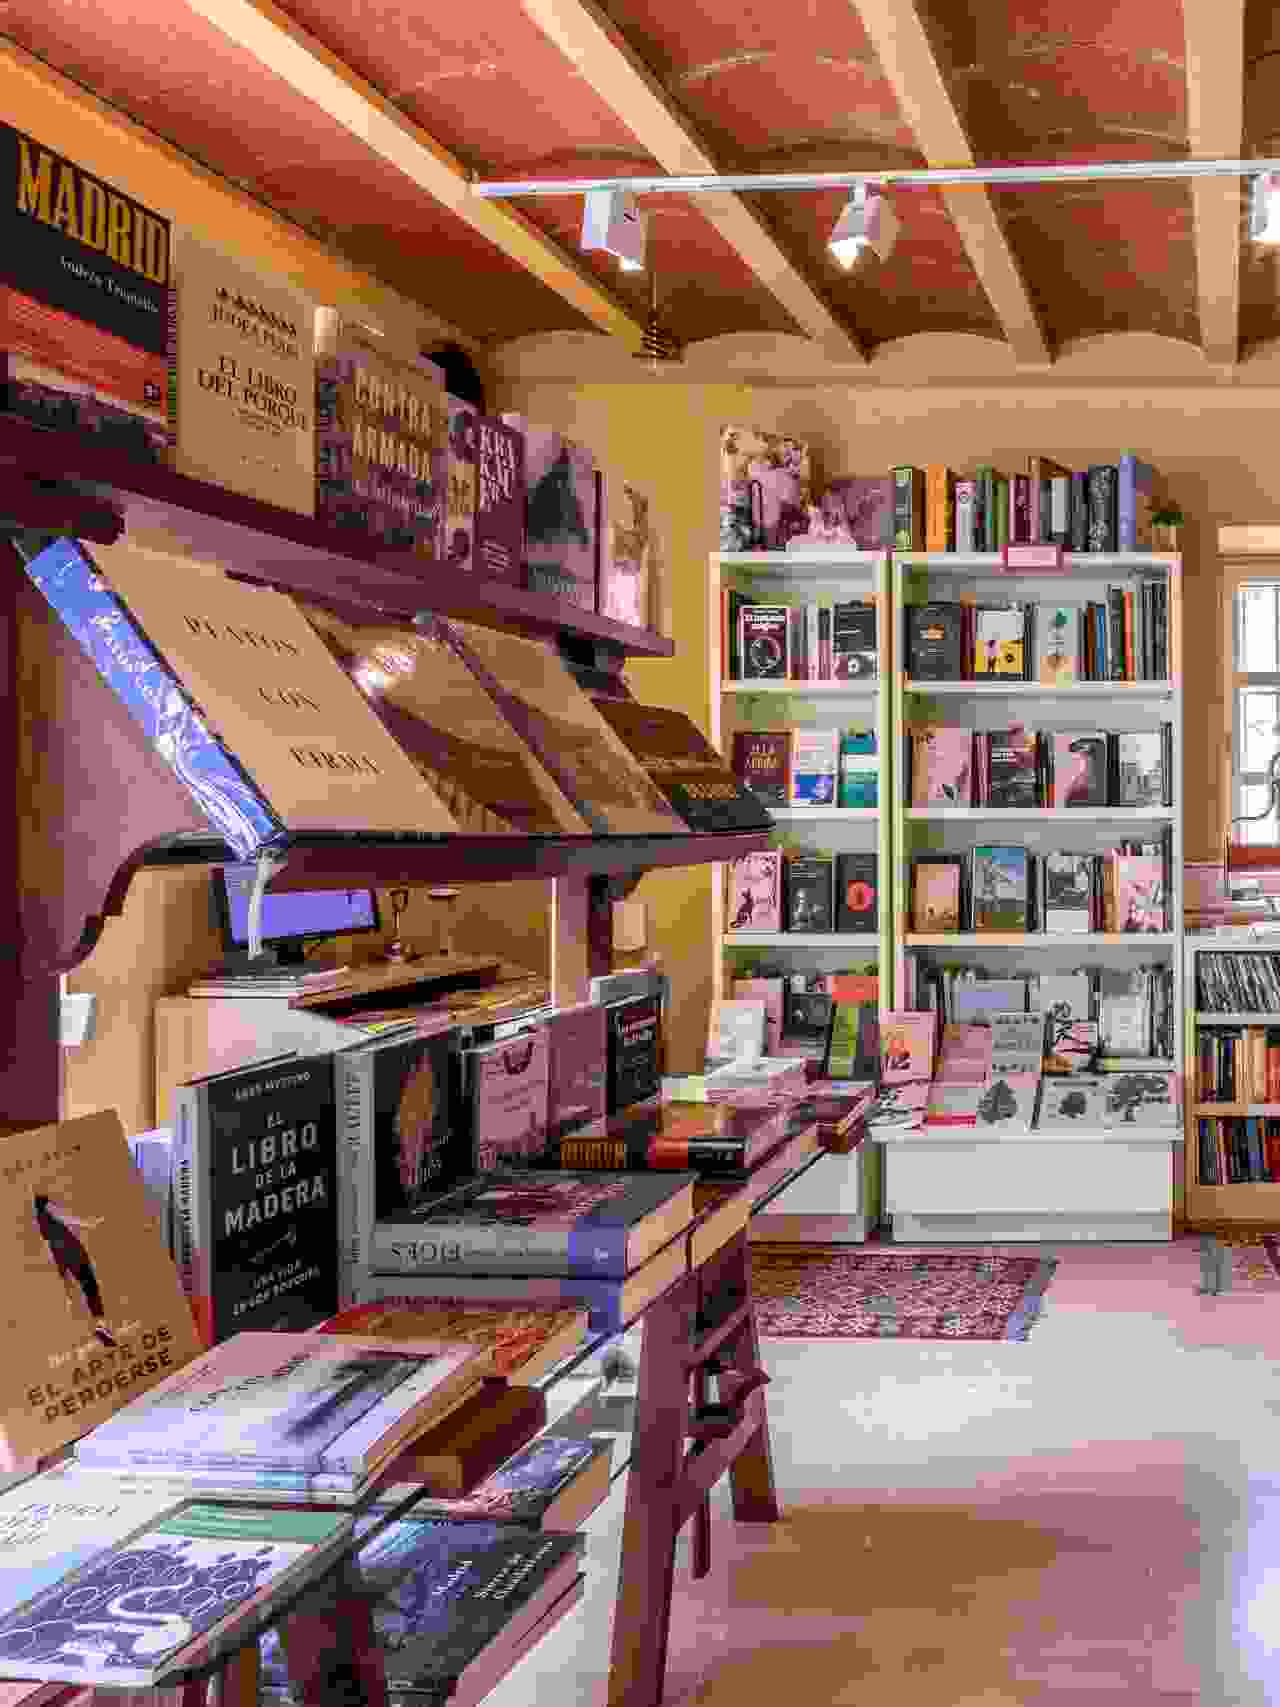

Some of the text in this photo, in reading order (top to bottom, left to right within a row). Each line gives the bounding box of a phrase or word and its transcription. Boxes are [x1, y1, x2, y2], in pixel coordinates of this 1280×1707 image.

[16, 143, 169, 286] MADRID
[193, 367, 236, 400] DEL
[217, 354, 297, 406] EL LIBRO
[353, 367, 434, 438] CONTRA
[352, 423, 434, 481] ARMADA
[231, 1121, 319, 1176] LIBRO
[267, 1111, 286, 1130] EL
[255, 1161, 298, 1190] DE LA
[224, 1174, 327, 1238] MADERA
[27, 1382, 62, 1408] EL
[72, 1342, 136, 1387] ARTE
[141, 1326, 174, 1353] DE
[45, 1348, 174, 1424] PERDERSE
